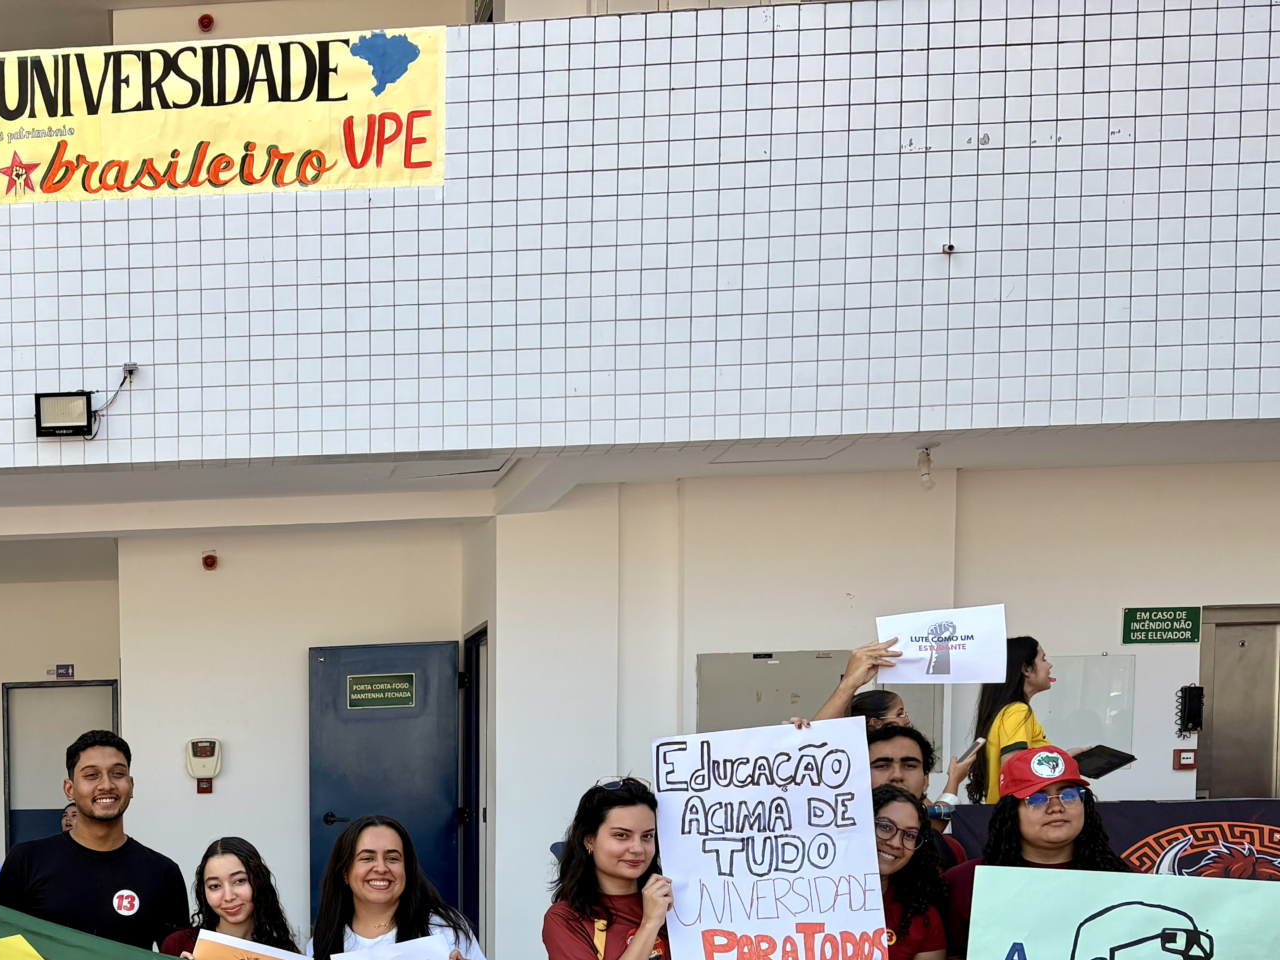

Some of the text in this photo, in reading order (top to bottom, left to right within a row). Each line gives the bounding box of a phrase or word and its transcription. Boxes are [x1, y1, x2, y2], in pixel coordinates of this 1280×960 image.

[7, 124, 75, 144] patrimônio
[343, 110, 432, 170] UPE
[39, 139, 338, 194] brasileiro
[1136, 611, 1187, 620] EM CASO DE
[1130, 620, 1192, 630] INCÊNDIO NÃO
[910, 635, 929, 643] LUTE
[931, 635, 958, 643] COMO
[1130, 631, 1191, 640] USE ELEVADOR
[918, 643, 967, 651] ESTUDANTE
[372, 682, 409, 690] CORTA-FOGO
[351, 692, 384, 700] MANTENHA
[681, 792, 857, 836] ACIMA DE
[702, 832, 837, 877] TUDO
[116, 894, 136, 912] 13
[672, 872, 881, 927] UNIVERSIDADE
